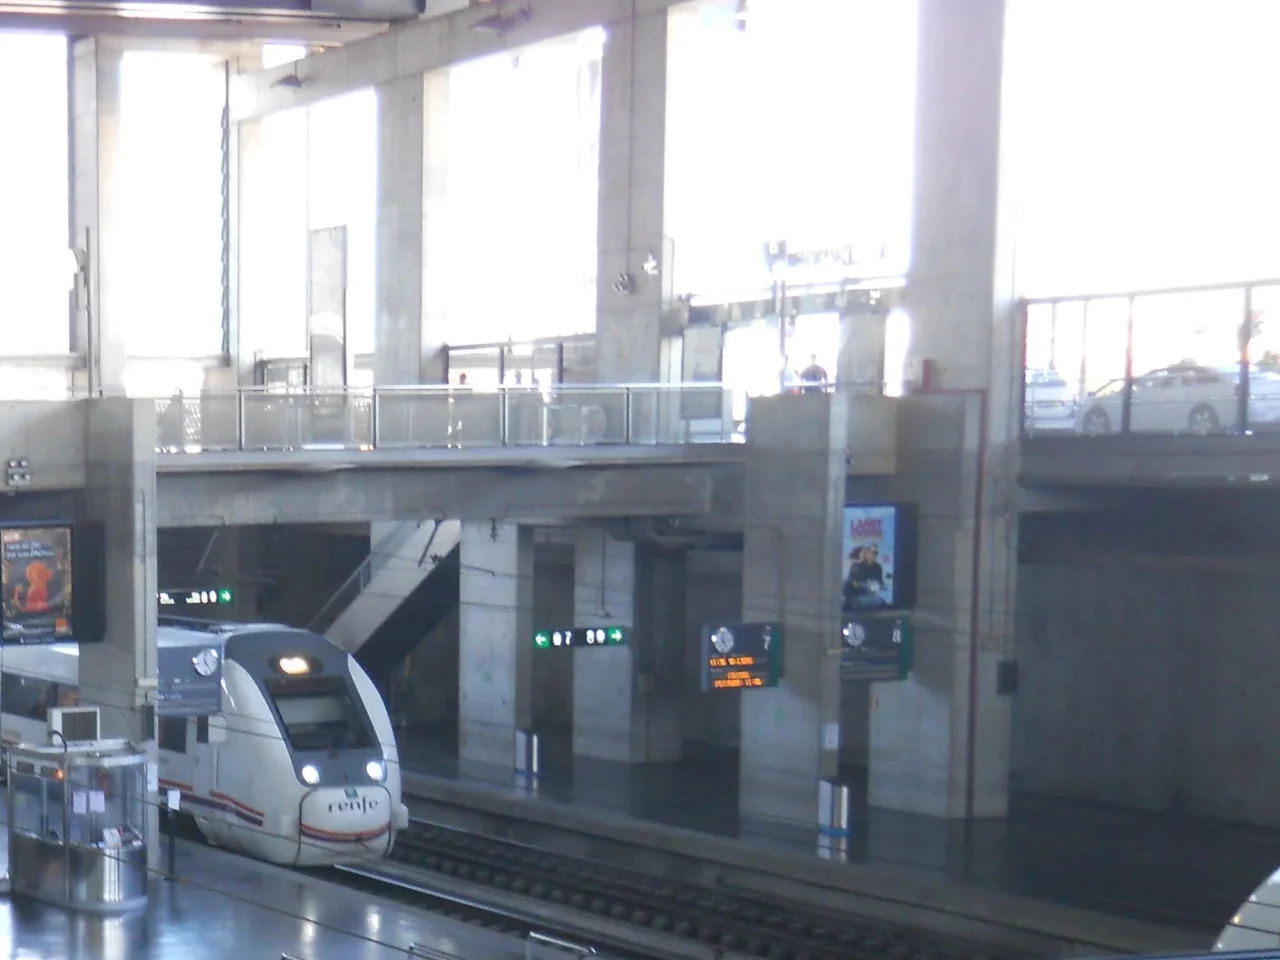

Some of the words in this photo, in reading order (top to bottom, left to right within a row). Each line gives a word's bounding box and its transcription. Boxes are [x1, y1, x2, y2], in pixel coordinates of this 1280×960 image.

[564, 630, 572, 646] 7
[762, 634, 771, 650] 7
[328, 795, 379, 815] renfe
